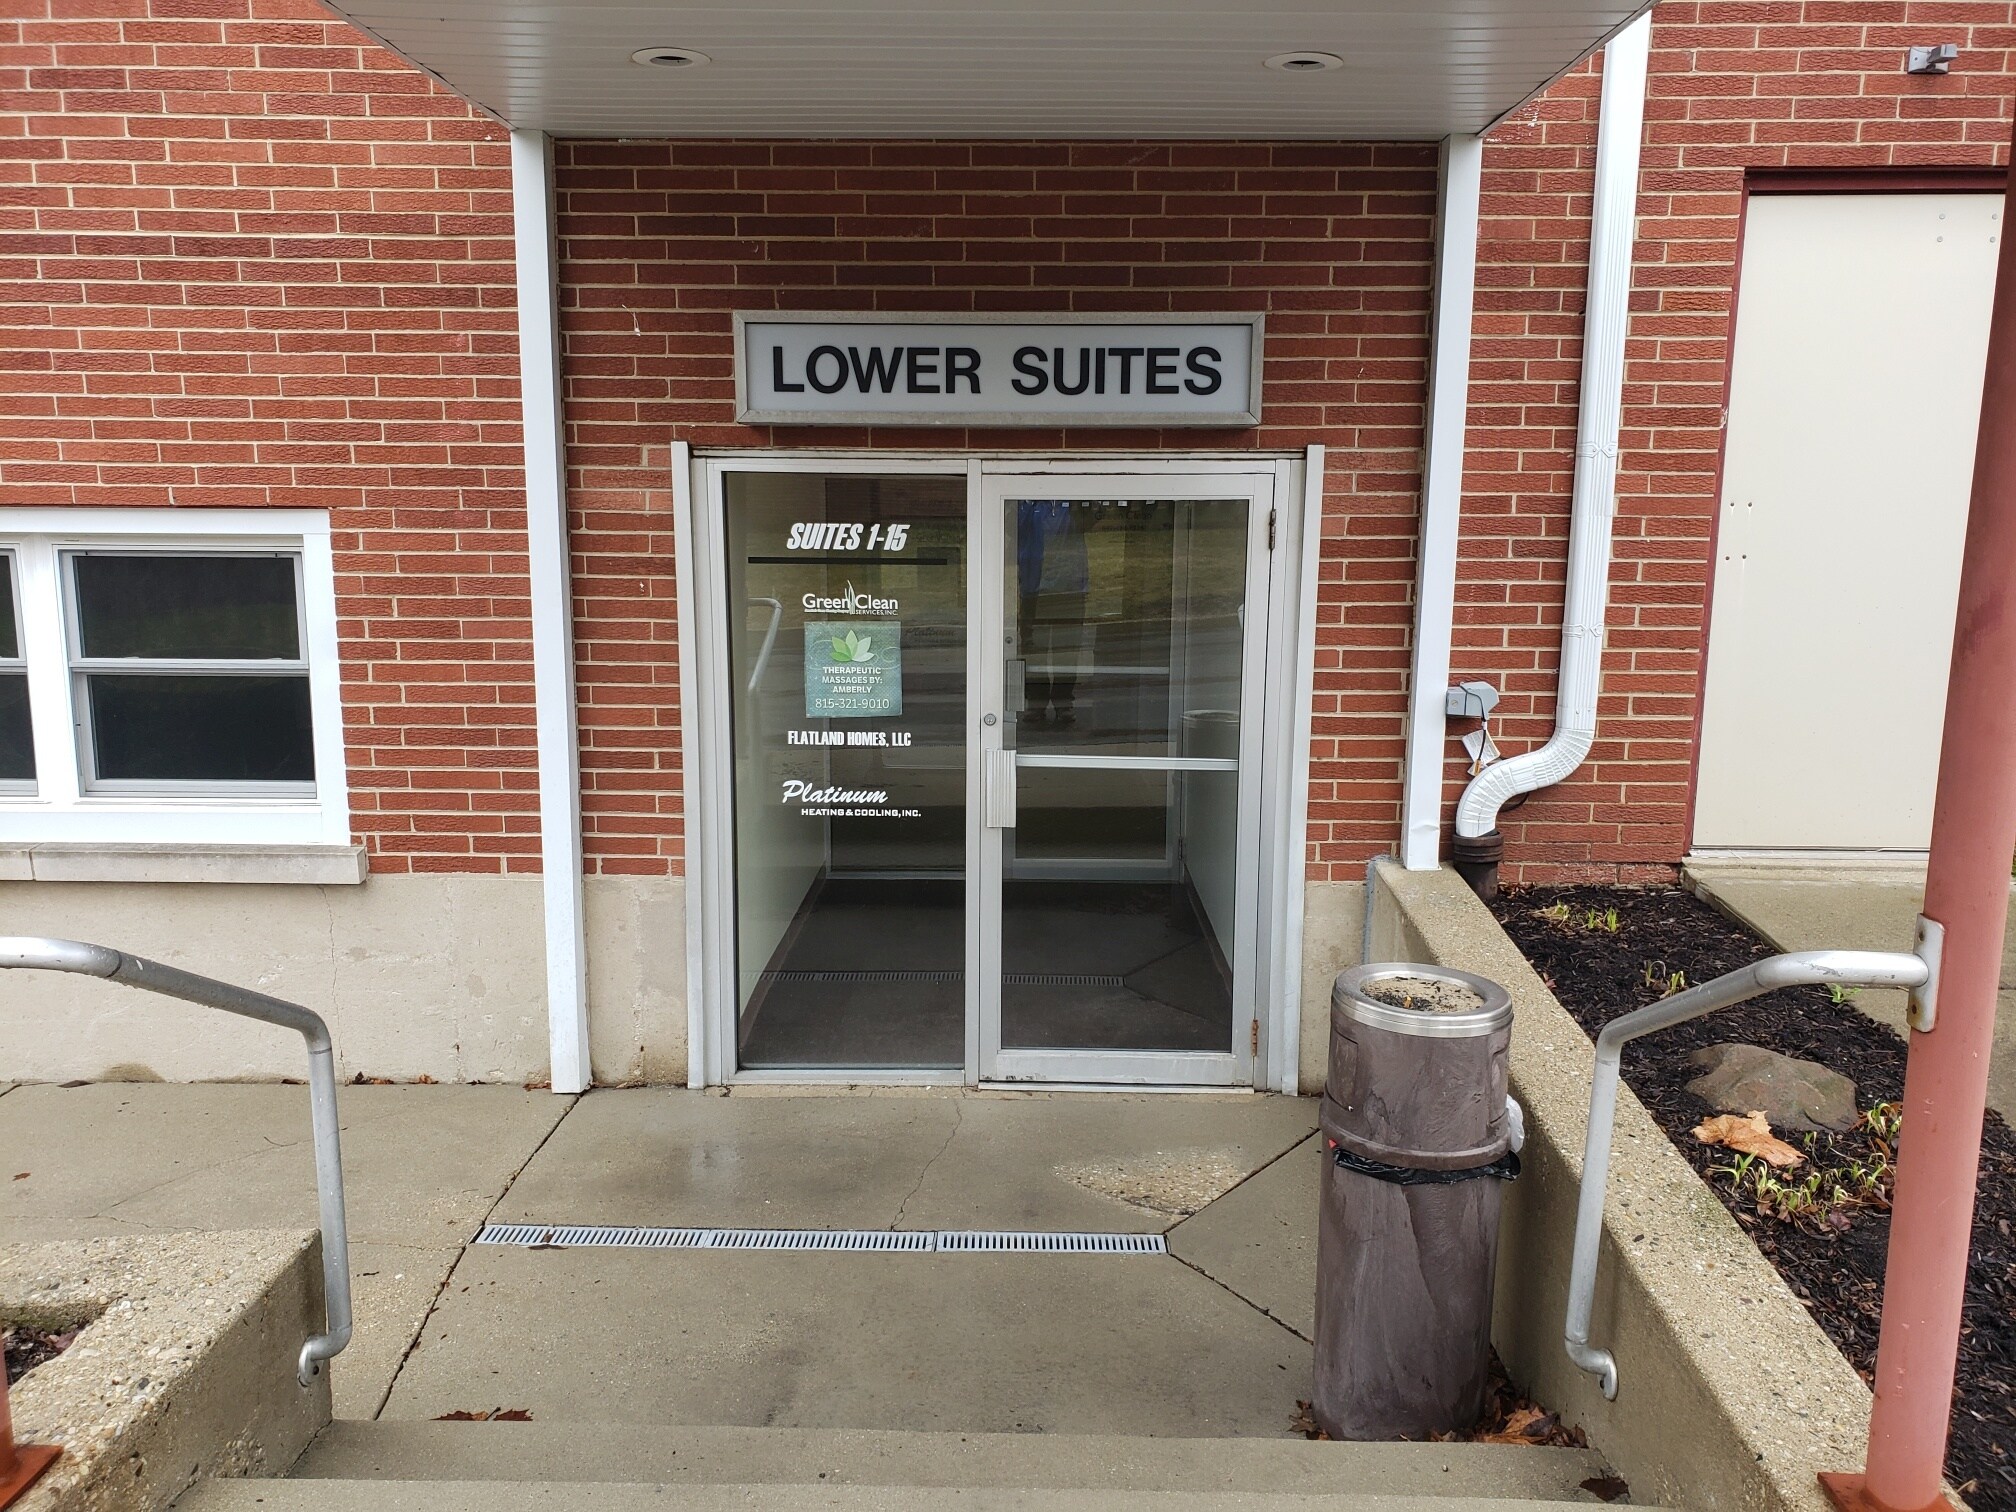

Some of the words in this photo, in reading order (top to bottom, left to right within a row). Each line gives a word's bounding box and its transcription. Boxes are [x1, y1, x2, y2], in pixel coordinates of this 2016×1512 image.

[773, 344, 982, 395] LOWER
[1010, 346, 1223, 396] SUITES
[786, 522, 864, 551] SUITES
[866, 523, 911, 551] 1-15
[802, 593, 850, 609] Green
[855, 594, 899, 610] Clean
[822, 666, 882, 675] THERAPEUTIC
[821, 676, 868, 684] MASSAGES
[869, 676, 883, 684] BY:
[832, 685, 873, 694] AMBERLY
[815, 698, 890, 709] 815-321-9010
[787, 730, 844, 746] FLATLAND
[847, 731, 890, 747] HOMES,
[891, 732, 912, 746] LLC
[781, 779, 889, 804] Platinum
[801, 808, 845, 816] HEATING
[854, 808, 901, 818] COOLING,
[901, 809, 922, 817] INC.
